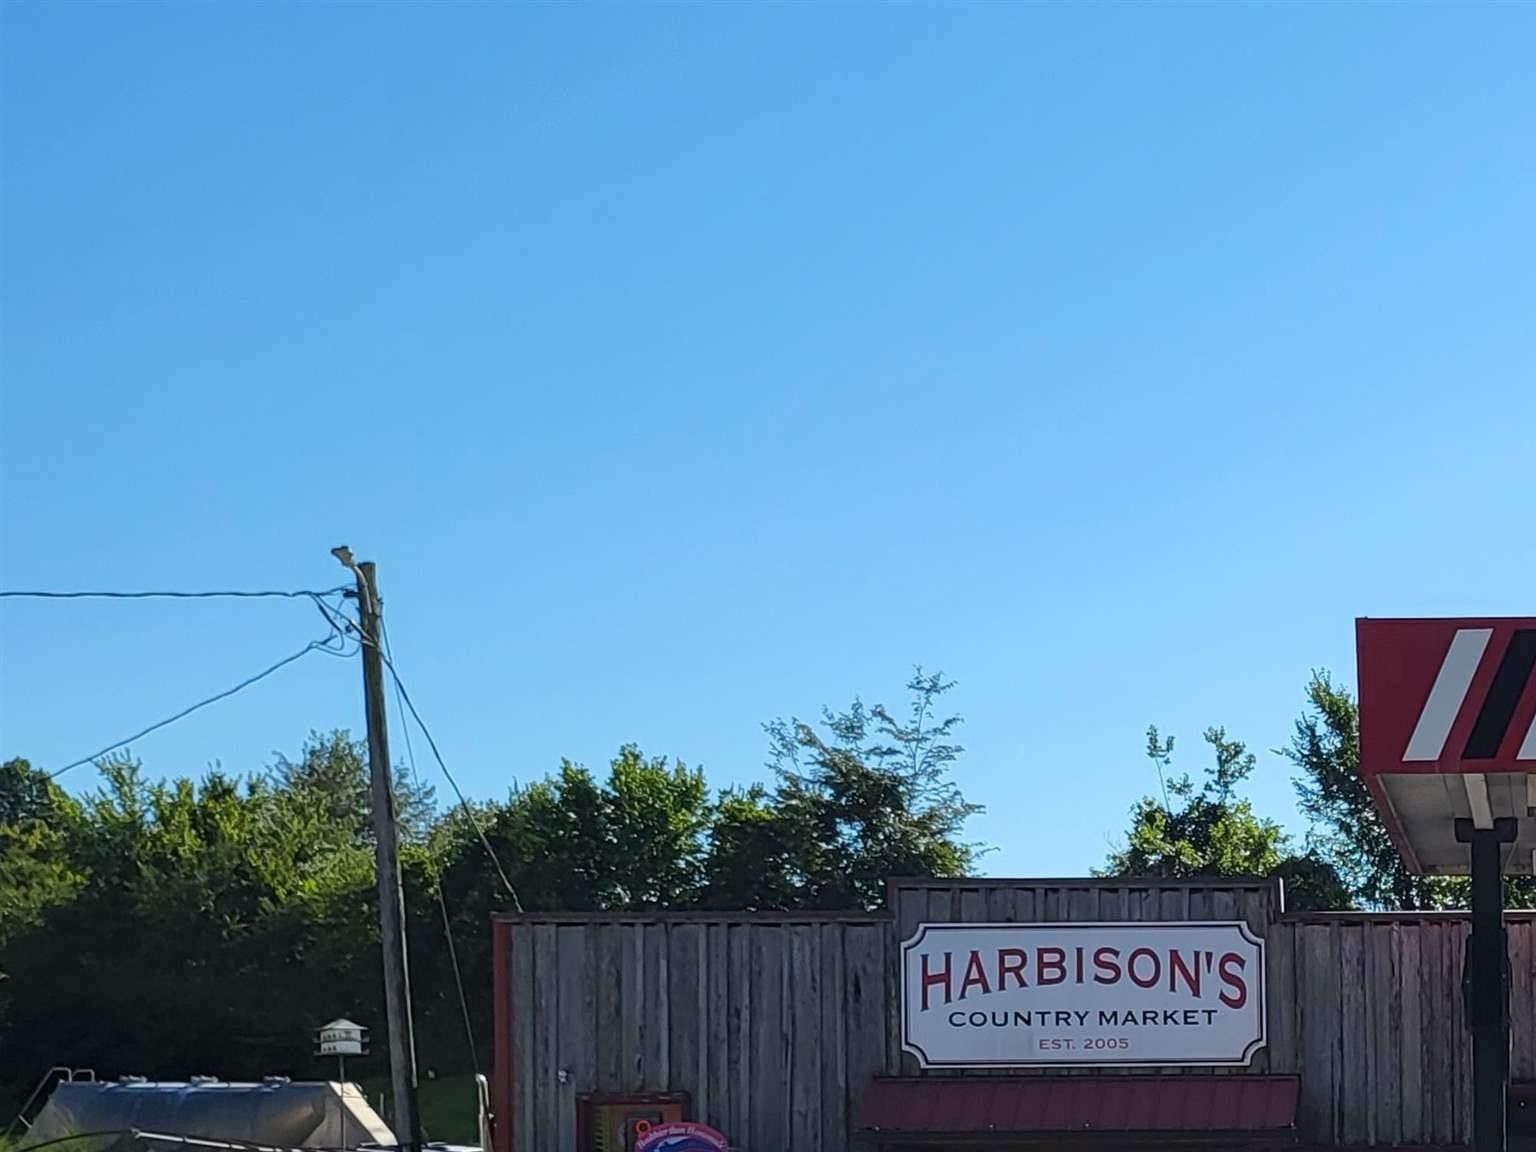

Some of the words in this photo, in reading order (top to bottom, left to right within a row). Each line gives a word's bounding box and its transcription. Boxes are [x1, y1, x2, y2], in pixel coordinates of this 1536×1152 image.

[919, 946, 1249, 1010] HARBISON'S
[948, 1010, 1090, 1027] COUNTRY
[1098, 1009, 1218, 1025] MARKET
[1038, 1038, 1075, 1050] EST.
[1083, 1037, 1129, 1050] 2005
